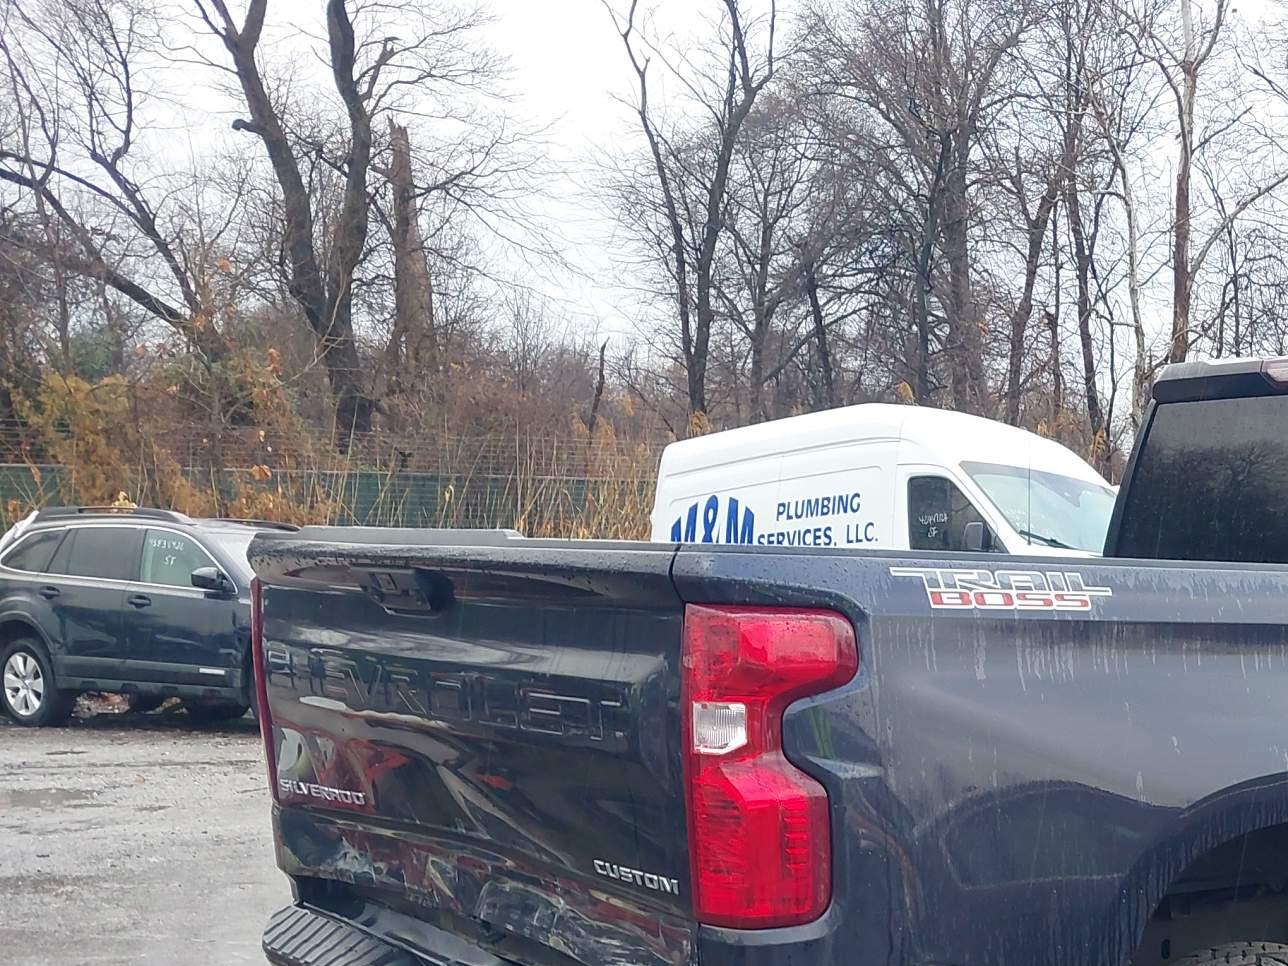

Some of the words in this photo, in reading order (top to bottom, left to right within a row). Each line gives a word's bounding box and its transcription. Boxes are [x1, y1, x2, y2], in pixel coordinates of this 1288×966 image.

[670, 494, 755, 545] M&M
[776, 492, 861, 522] PLUMBING
[846, 521, 879, 544] LLC.
[889, 566, 1113, 597] TRAIL
[930, 589, 1091, 611] BOSS
[279, 779, 367, 806] SILVERADO
[593, 859, 680, 896] CUSTOM
